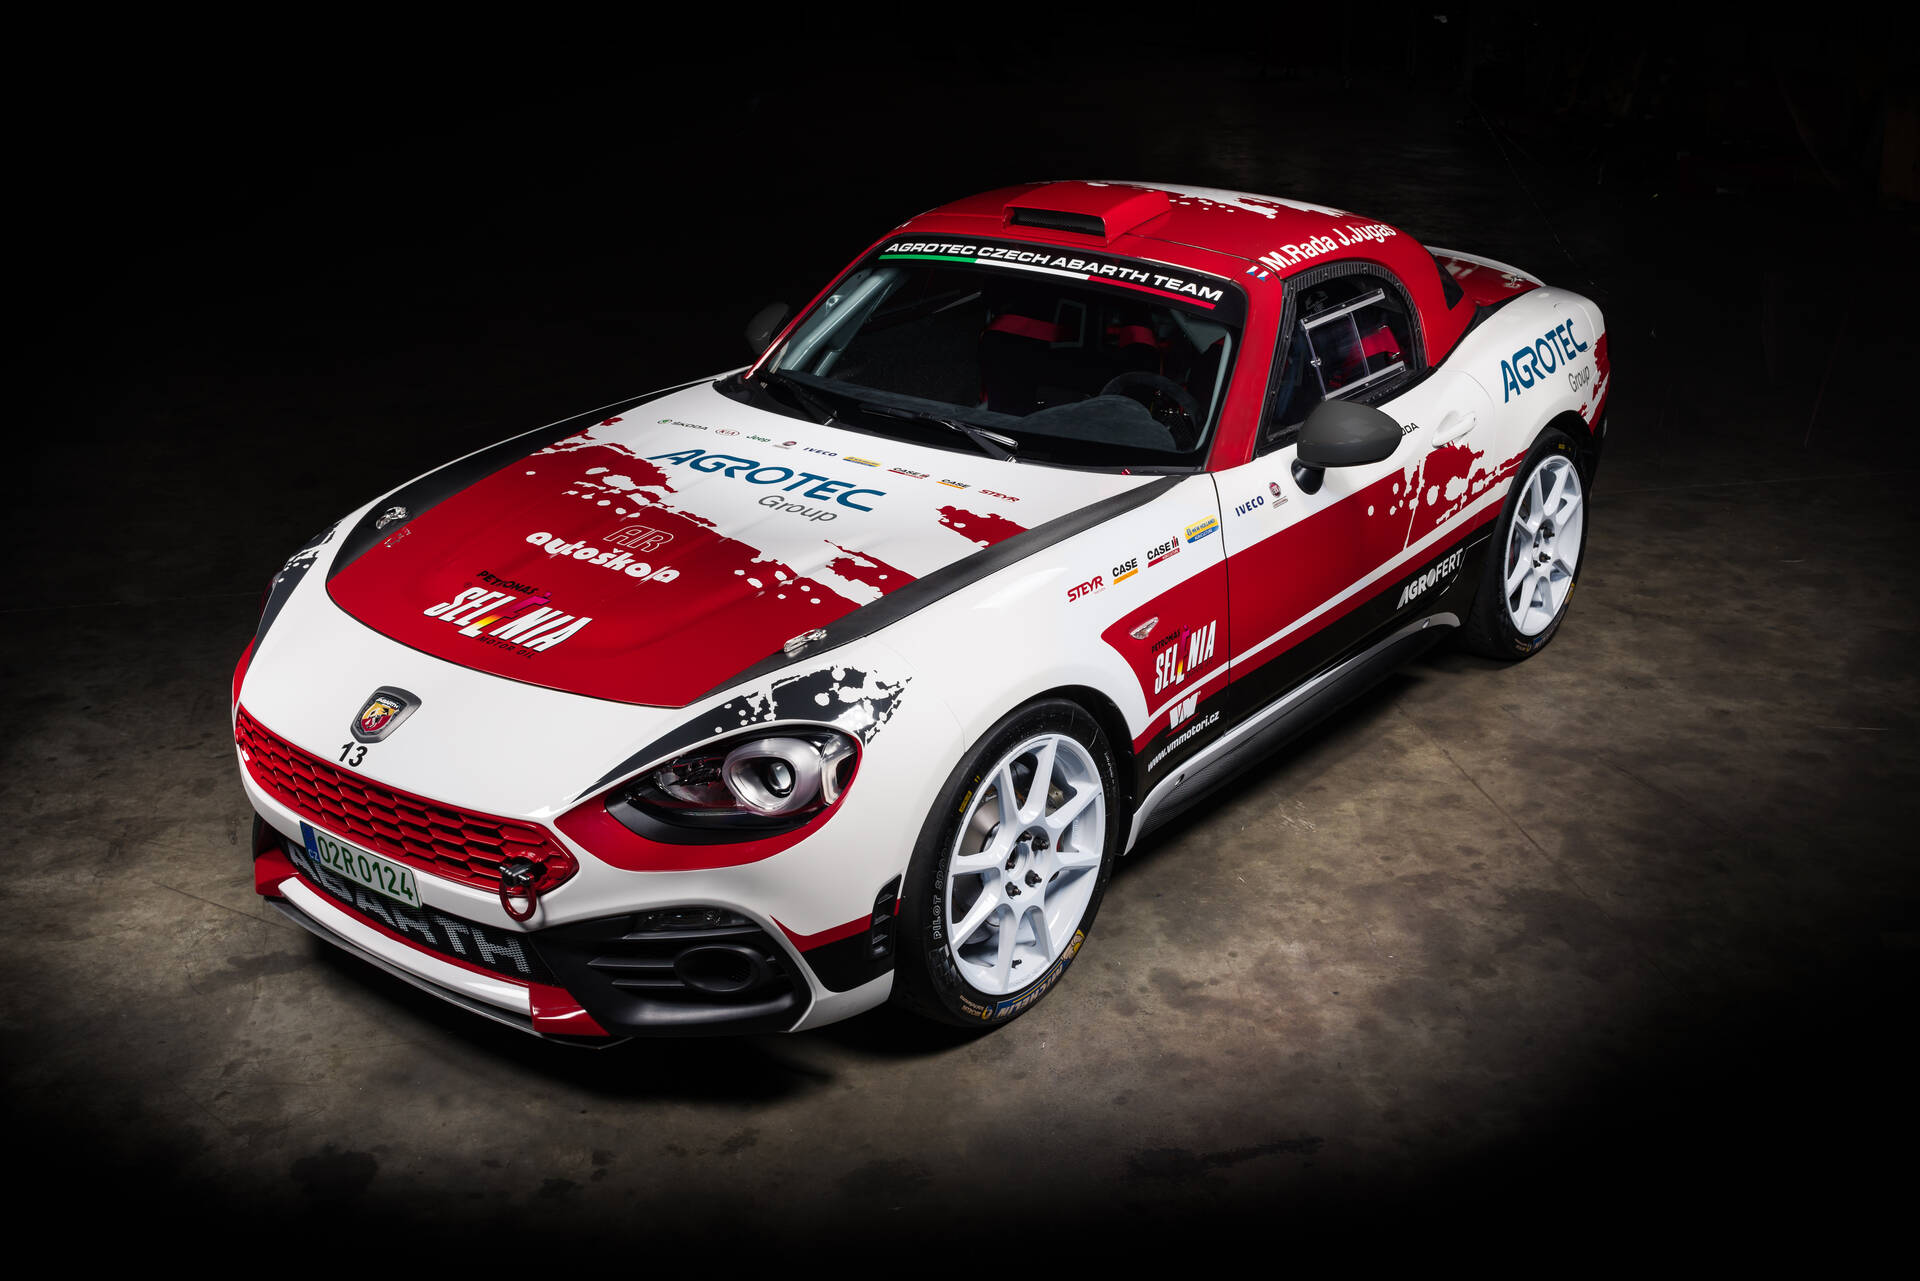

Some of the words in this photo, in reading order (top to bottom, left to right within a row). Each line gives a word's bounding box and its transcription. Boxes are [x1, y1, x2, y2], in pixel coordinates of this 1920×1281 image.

[1258, 233, 1340, 271] M.Rada
[1332, 223, 1397, 247] J.Jugas
[885, 242, 974, 256] AGROTEC
[977, 246, 1051, 266] CZECH
[1049, 254, 1150, 284] ABARTH
[1153, 274, 1223, 302] TEAM
[1501, 318, 1588, 404] AGROTEC
[1568, 365, 1590, 392] Group
[803, 446, 838, 457] IVECO
[646, 448, 887, 512] AGROTEC
[941, 478, 971, 489] CASE
[758, 494, 838, 523] Group
[978, 489, 1020, 502] STEYR
[1235, 495, 1264, 517] IVECO
[525, 532, 681, 587] autoškola
[1146, 541, 1171, 561] CASE
[1112, 558, 1138, 578] CASE
[1397, 548, 1463, 610] AGROFERT
[477, 570, 539, 595] PETRONAS
[1067, 575, 1104, 603] STEYR
[423, 587, 594, 652] SELENIA
[1155, 619, 1216, 695] SELENIA
[339, 741, 368, 767] 13
[1148, 710, 1220, 773] www.vmmotori.cz
[307, 848, 320, 861] CZ
[932, 894, 942, 940] PILOT
